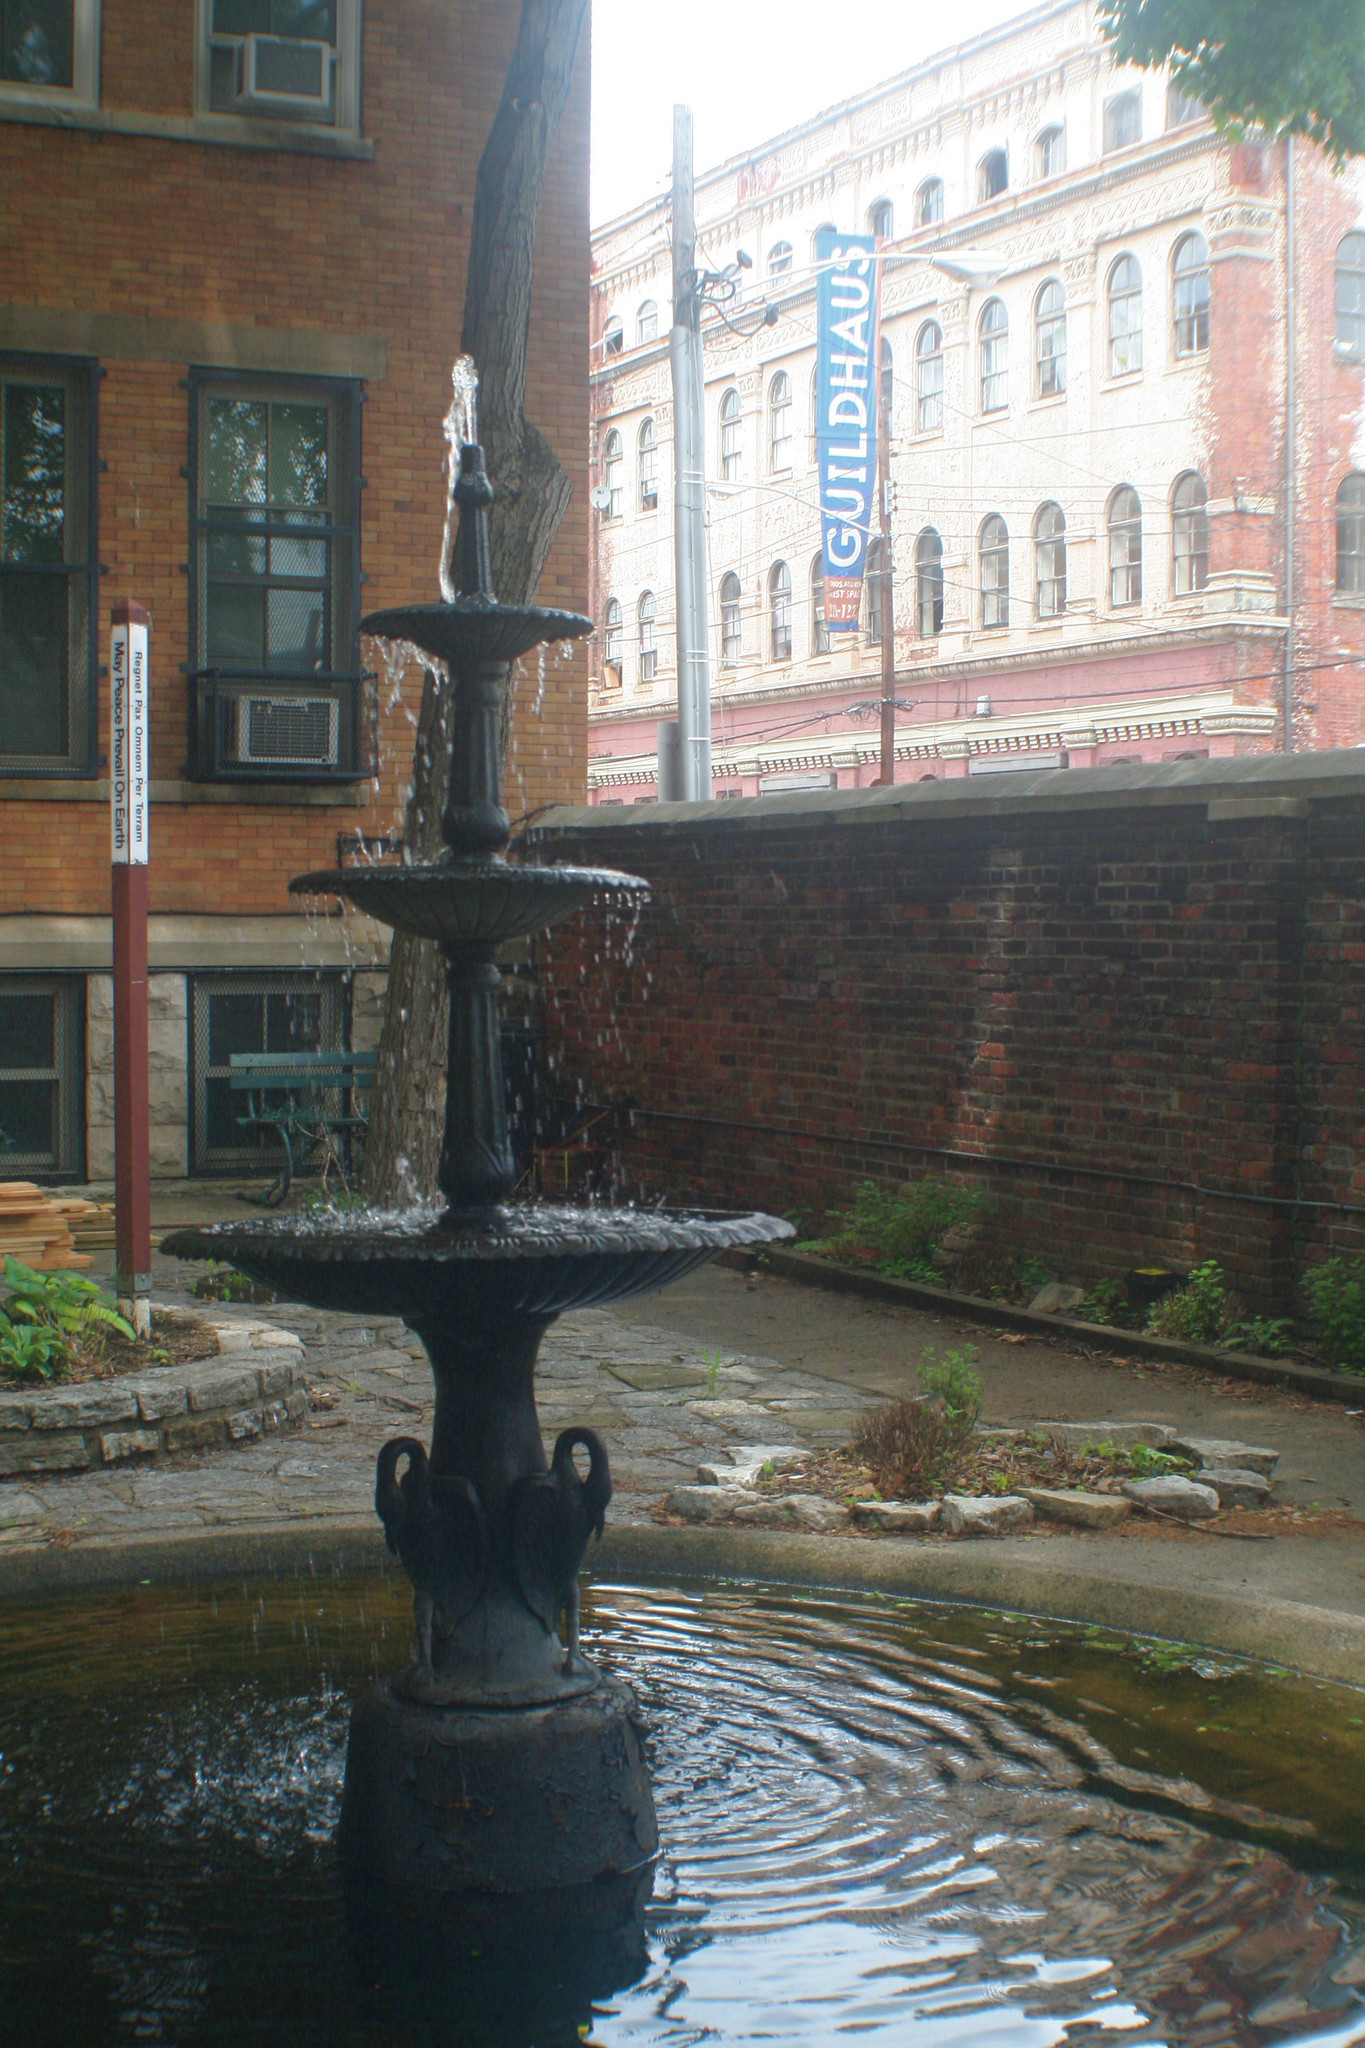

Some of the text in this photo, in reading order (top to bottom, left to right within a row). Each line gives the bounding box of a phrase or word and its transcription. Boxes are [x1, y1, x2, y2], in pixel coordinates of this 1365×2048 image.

[826, 245, 870, 567] GUILDHAUS
[113, 642, 125, 849] May Peace Prevail On Earth
[133, 651, 144, 842] Regnet Pax Omnem Per Terram
